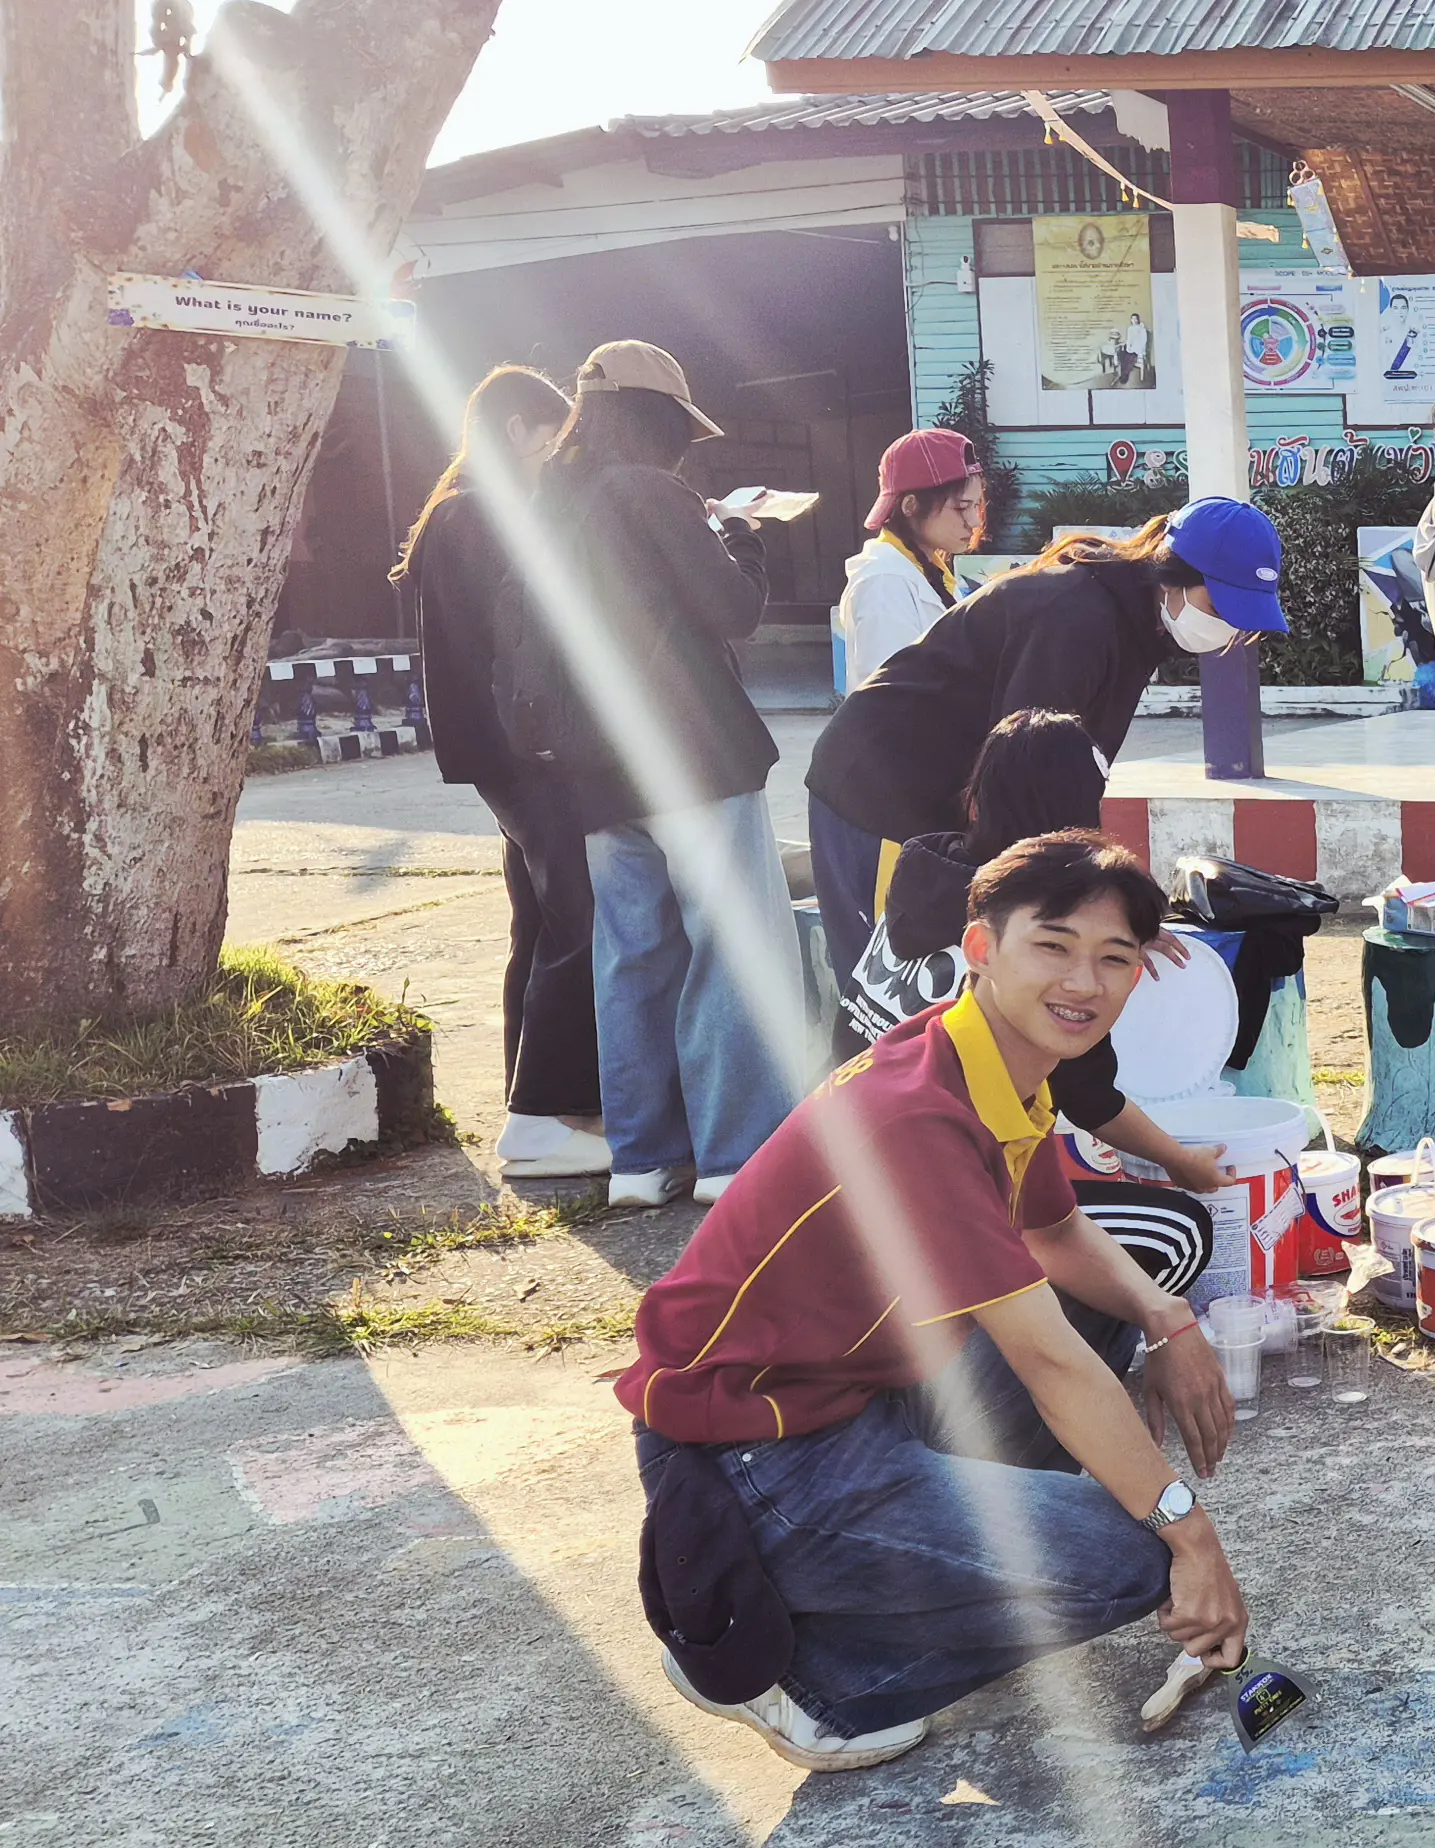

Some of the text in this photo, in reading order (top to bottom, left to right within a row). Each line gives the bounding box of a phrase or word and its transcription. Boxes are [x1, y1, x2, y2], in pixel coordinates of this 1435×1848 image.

[174, 295, 353, 323] What is your name?
